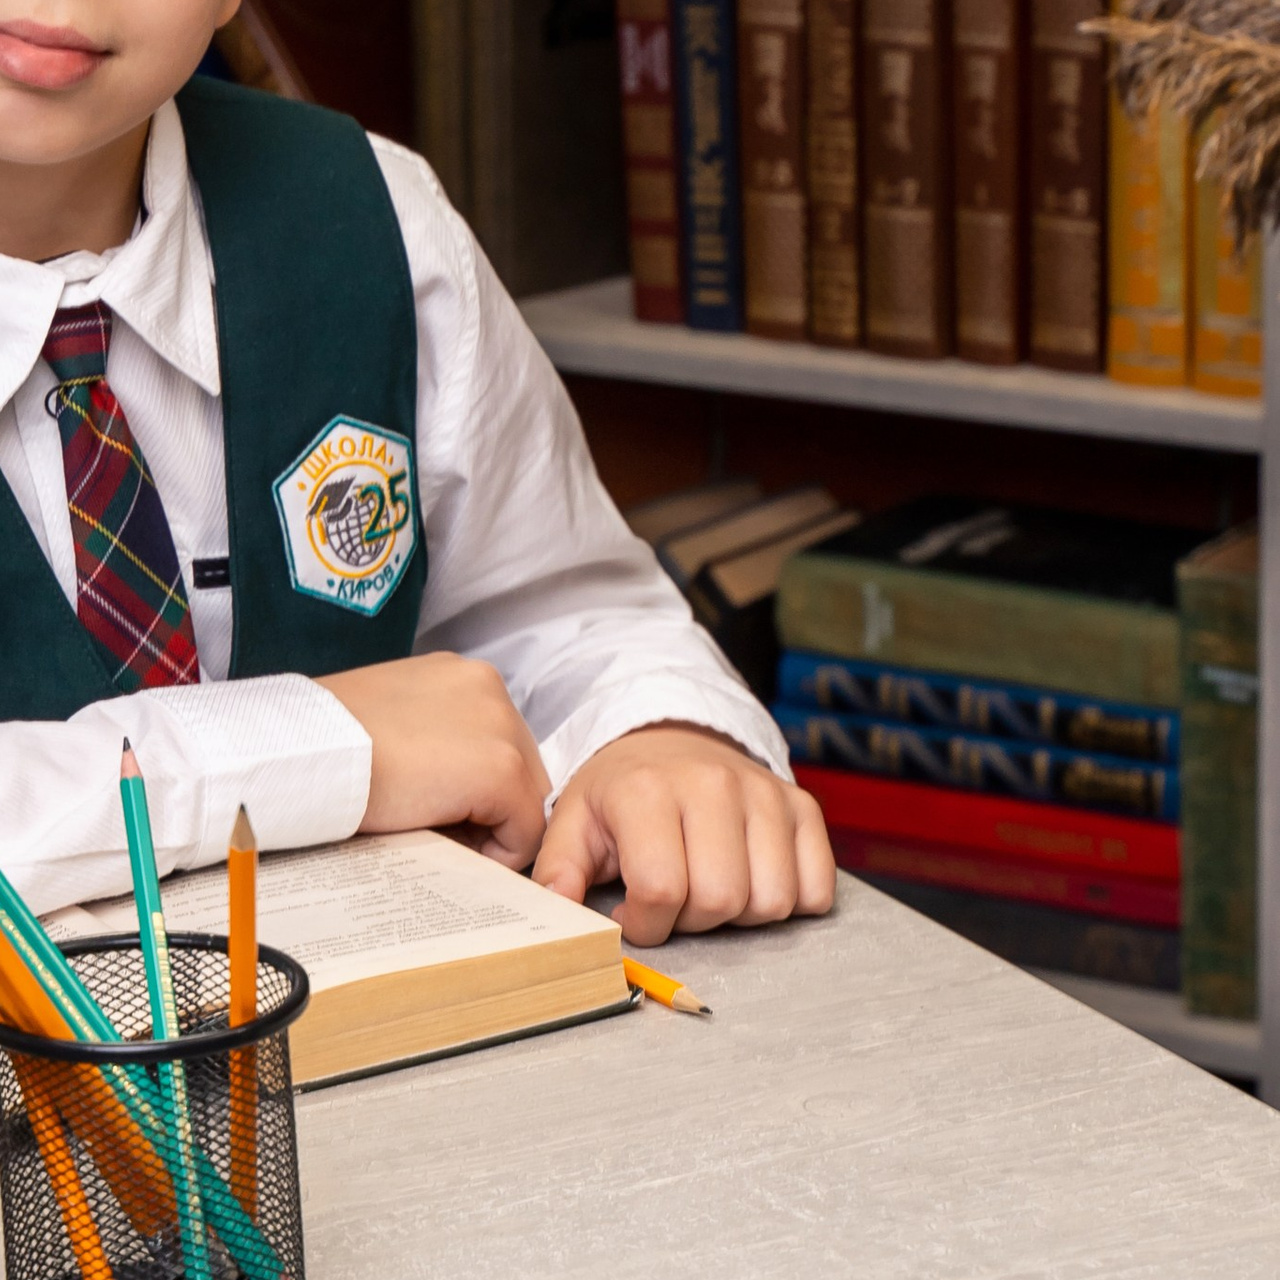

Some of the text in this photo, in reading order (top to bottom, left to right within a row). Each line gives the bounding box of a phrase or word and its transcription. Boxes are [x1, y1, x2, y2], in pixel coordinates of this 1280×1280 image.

[301, 433, 389, 480] ШКОЛА
[359, 470, 412, 545] 25
[335, 568, 395, 600] КИРОВ
